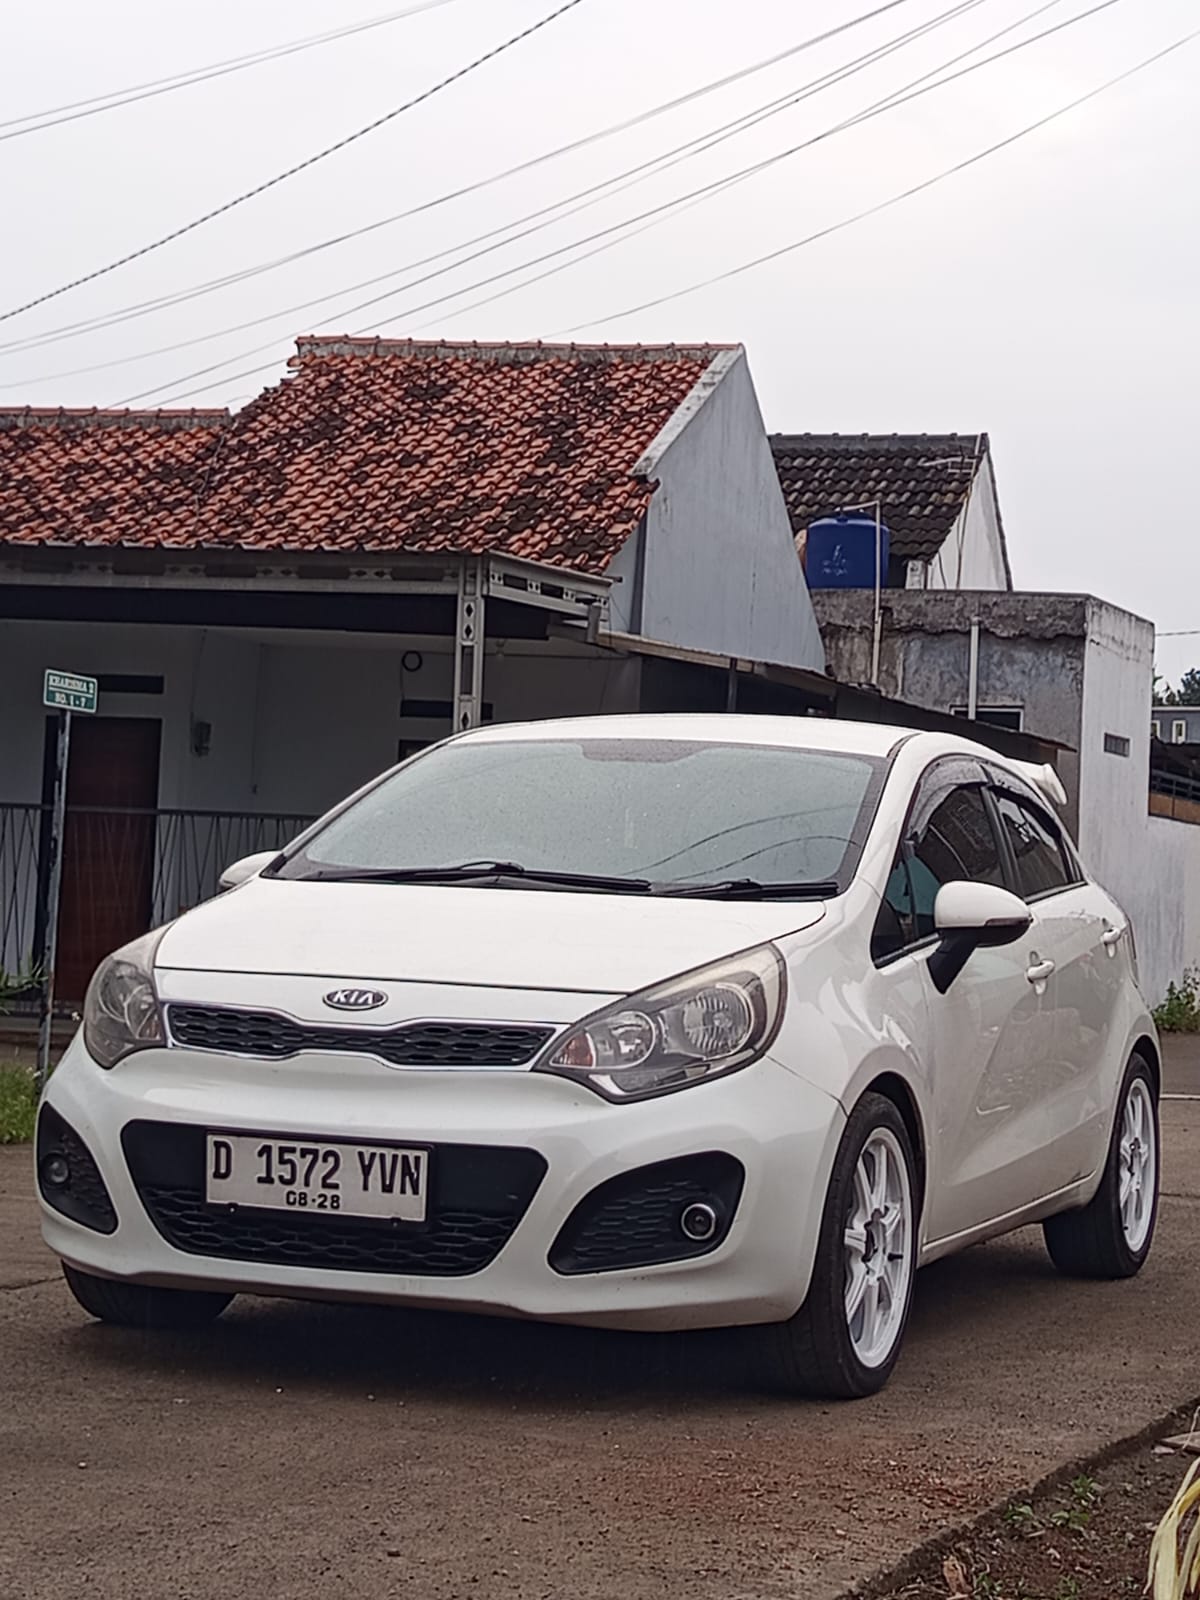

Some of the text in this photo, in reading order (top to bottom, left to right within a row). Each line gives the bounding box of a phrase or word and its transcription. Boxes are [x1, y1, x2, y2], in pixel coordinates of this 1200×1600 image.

[333, 991, 373, 1004] KIA
[213, 1140, 421, 1195] D 1572 YVN
